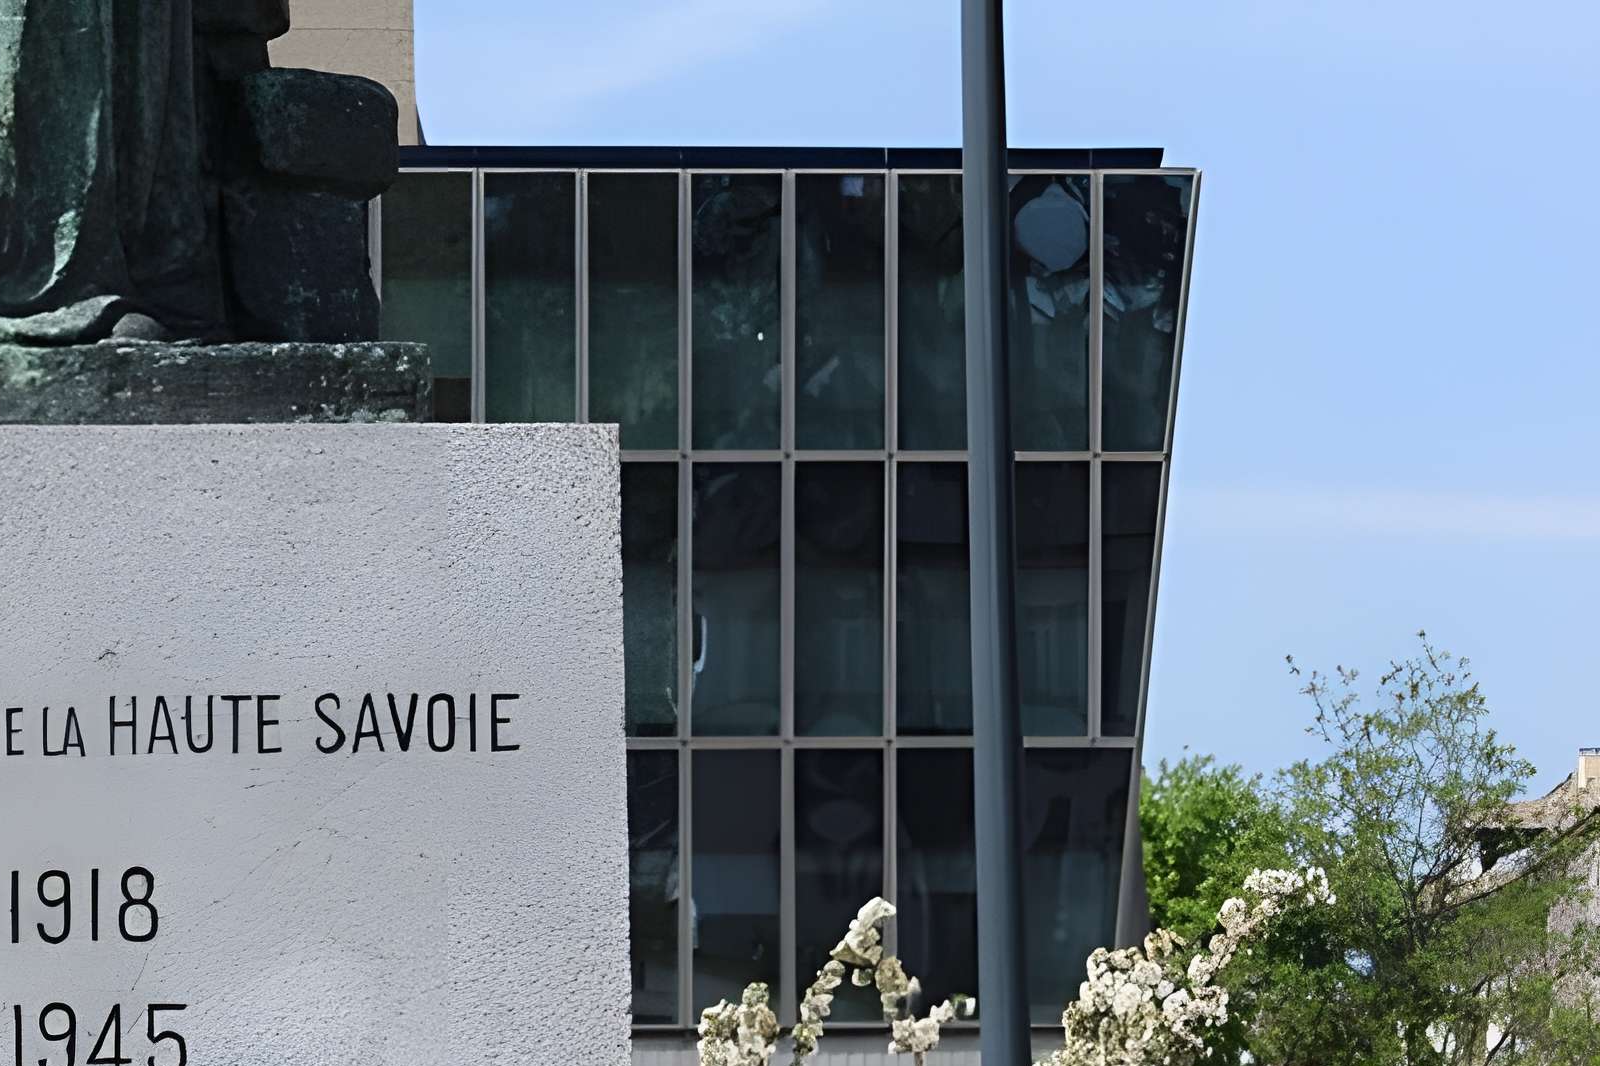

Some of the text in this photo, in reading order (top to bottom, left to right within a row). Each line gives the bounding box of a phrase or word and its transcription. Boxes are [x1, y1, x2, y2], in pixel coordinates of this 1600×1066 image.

[42, 706, 86, 757] LA
[109, 694, 282, 756] HAUTE
[314, 692, 521, 754] SAVOIE
